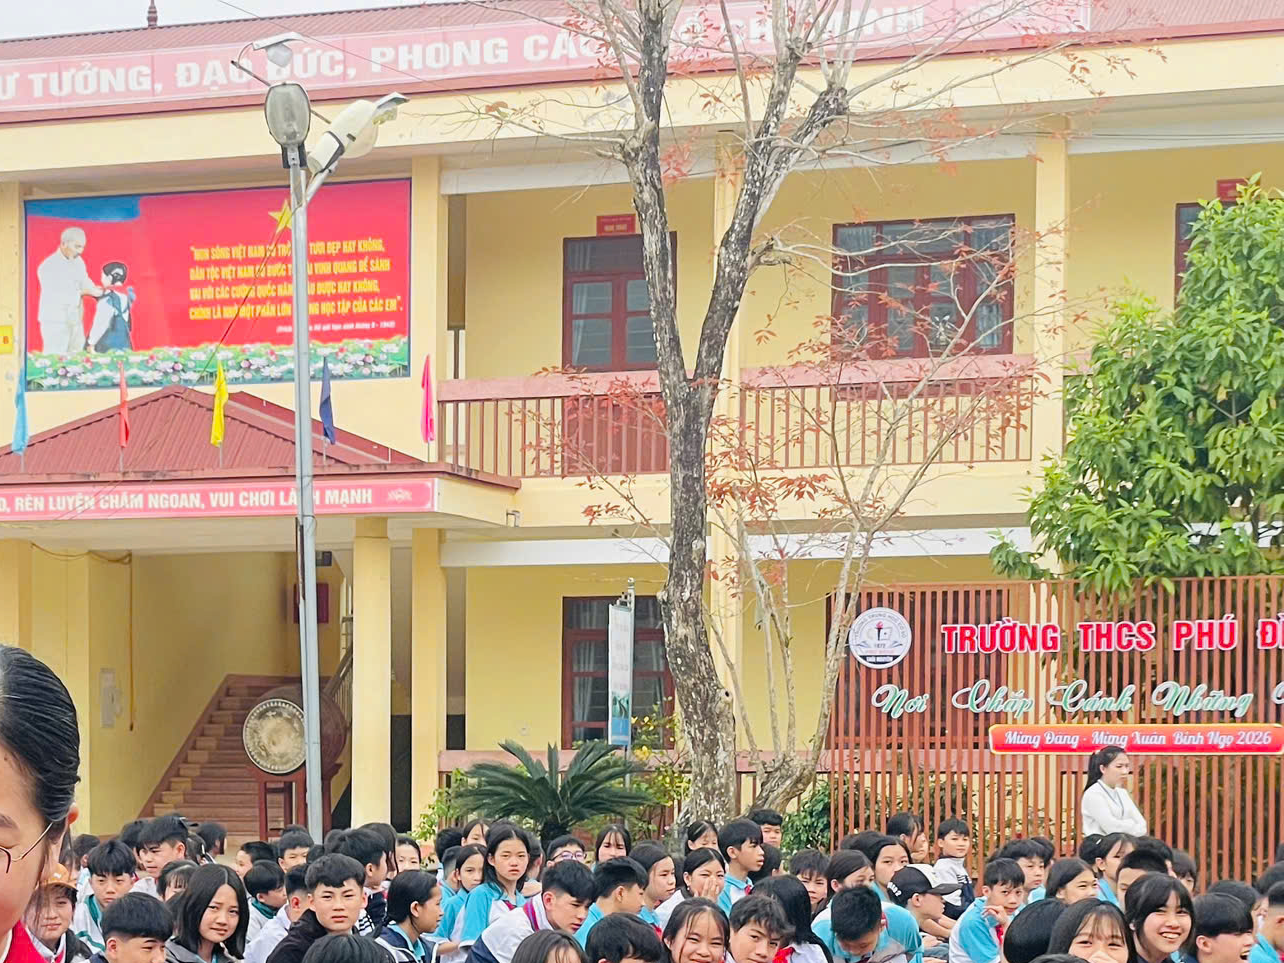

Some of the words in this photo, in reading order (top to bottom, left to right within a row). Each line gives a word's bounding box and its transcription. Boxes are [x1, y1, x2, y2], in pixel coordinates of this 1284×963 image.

[27, 62, 163, 98] TƯỞNG,
[175, 56, 253, 90] ĐẠO
[371, 39, 510, 74] PHONG
[15, 493, 45, 513] RÈN
[49, 491, 95, 515] LUYỆN
[148, 493, 205, 510] NGOAN,
[209, 491, 234, 508] VUI
[239, 490, 275, 507] CHƠI
[325, 488, 372, 508] MẠNH
[941, 616, 1061, 654] TRƯỜNG
[1077, 620, 1156, 652] THCS
[1173, 613, 1238, 651] PHÚ
[871, 684, 930, 719] Nơi
[952, 678, 1034, 719] Chắp
[1046, 680, 1136, 713] Cánh
[1152, 680, 1254, 718] Những
[1004, 730, 1041, 748] Mừng
[1092, 730, 1129, 748] Mừng
[1131, 730, 1166, 746] Xuân
[1236, 730, 1272, 746] 2026
